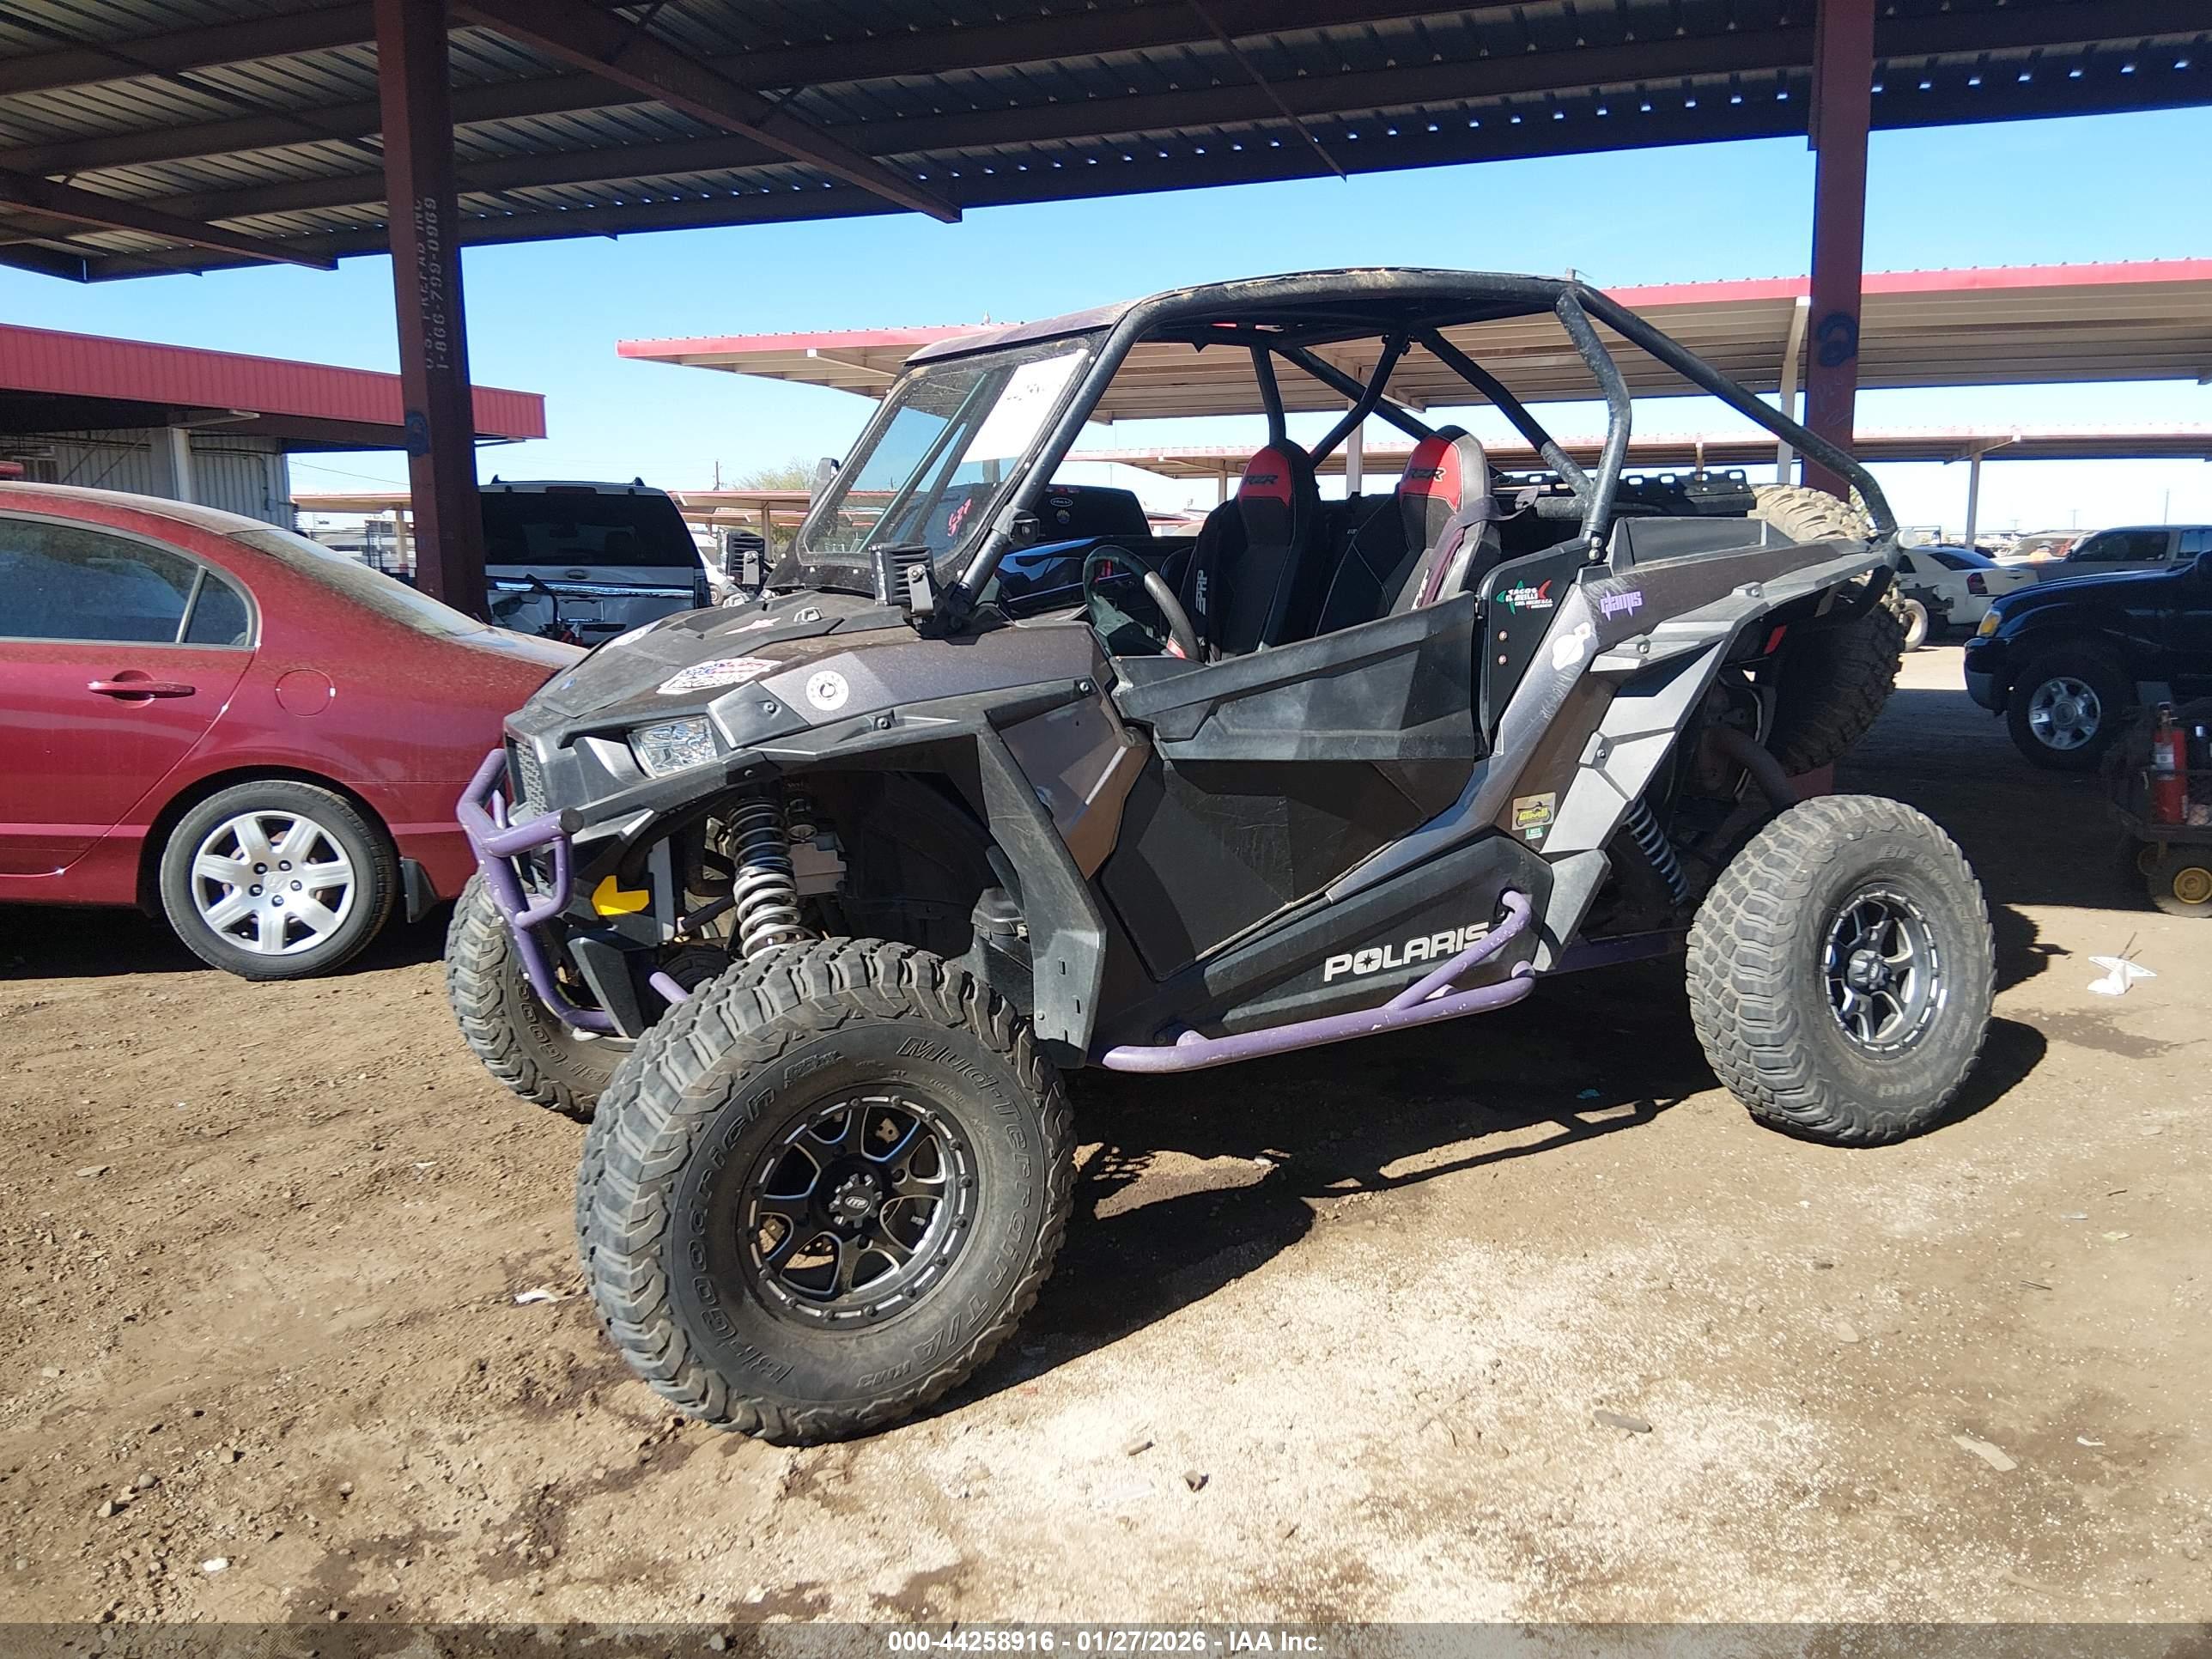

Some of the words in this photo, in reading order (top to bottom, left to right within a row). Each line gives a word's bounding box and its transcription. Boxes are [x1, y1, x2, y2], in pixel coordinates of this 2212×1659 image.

[1245, 474, 1279, 485] RZR
[1407, 466, 1448, 483] RZR
[1508, 586, 1538, 595] TACOS
[1323, 921, 1490, 982] POLARIS
[896, 1036, 1032, 1286] Mud-Terrain
[688, 1086, 795, 1383] BFGoodrich
